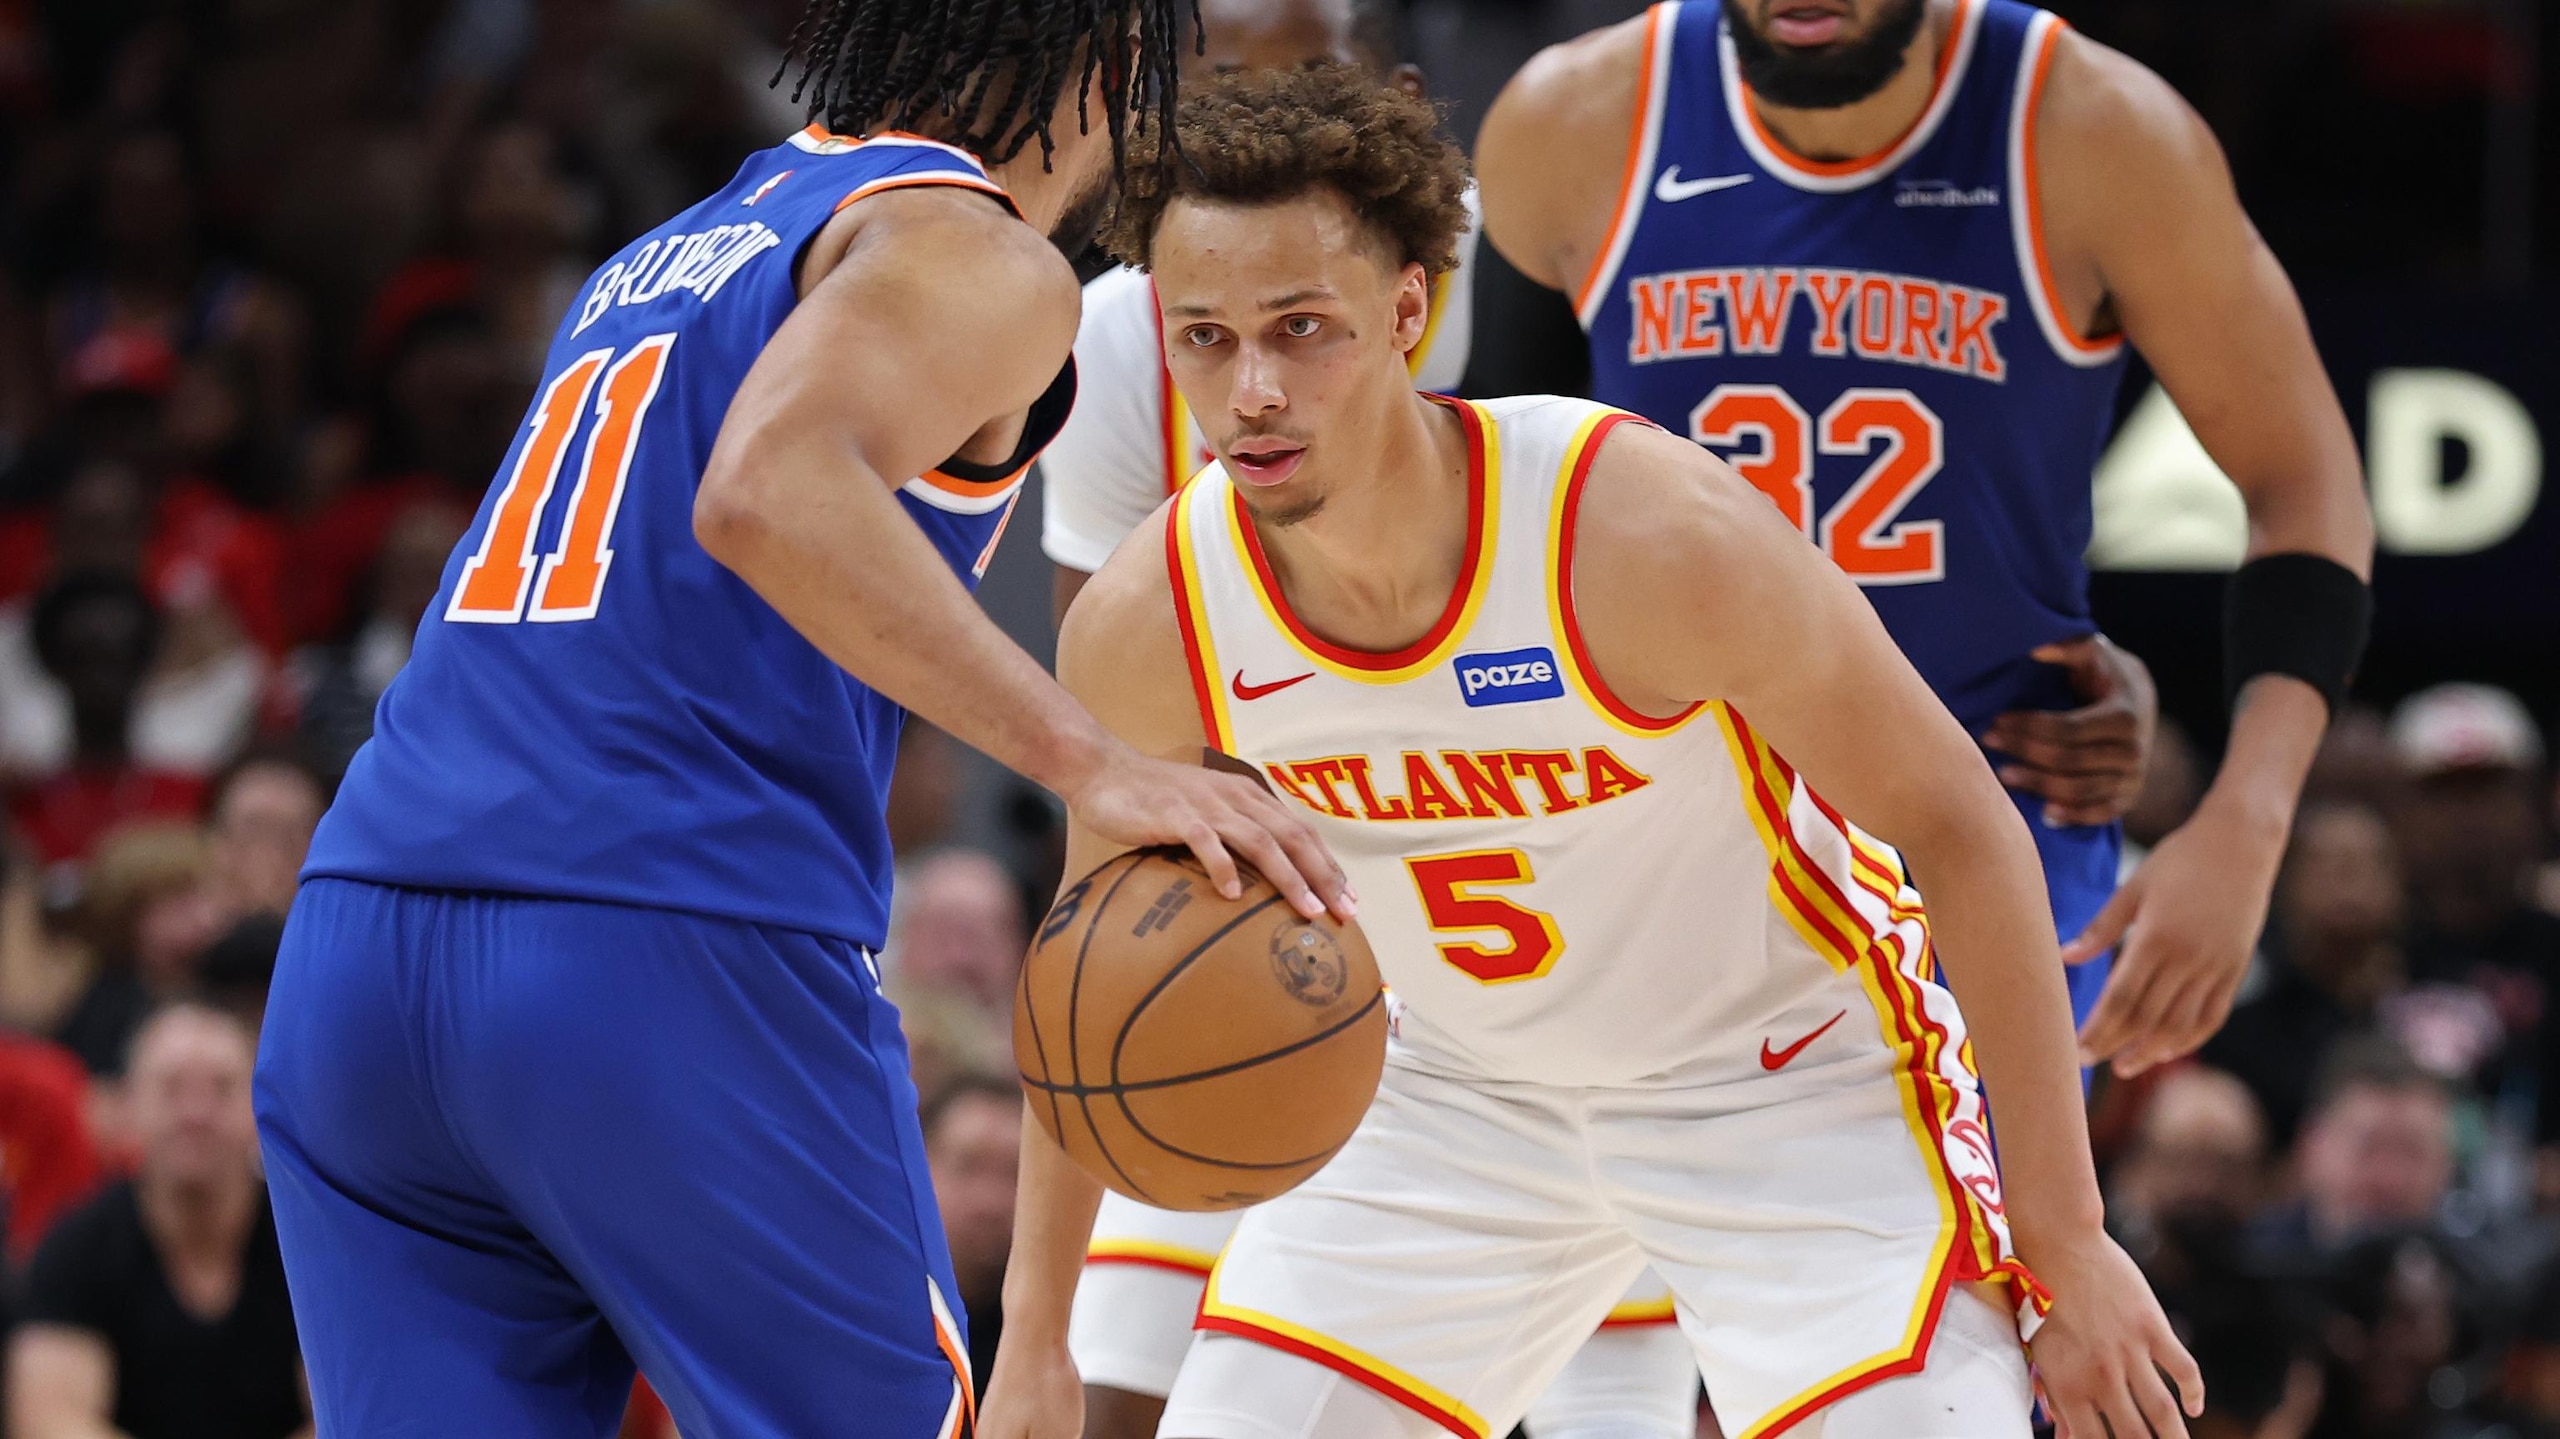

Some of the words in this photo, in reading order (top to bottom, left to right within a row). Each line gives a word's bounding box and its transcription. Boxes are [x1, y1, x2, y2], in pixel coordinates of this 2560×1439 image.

[570, 221, 781, 340] BRUNSON
[1629, 267, 1799, 366] NEW
[1804, 273, 2007, 383] YORK
[444, 332, 678, 623] 11
[1690, 384, 1945, 586] 32
[1462, 660, 1554, 695] paze
[1402, 848, 1566, 985] 5
